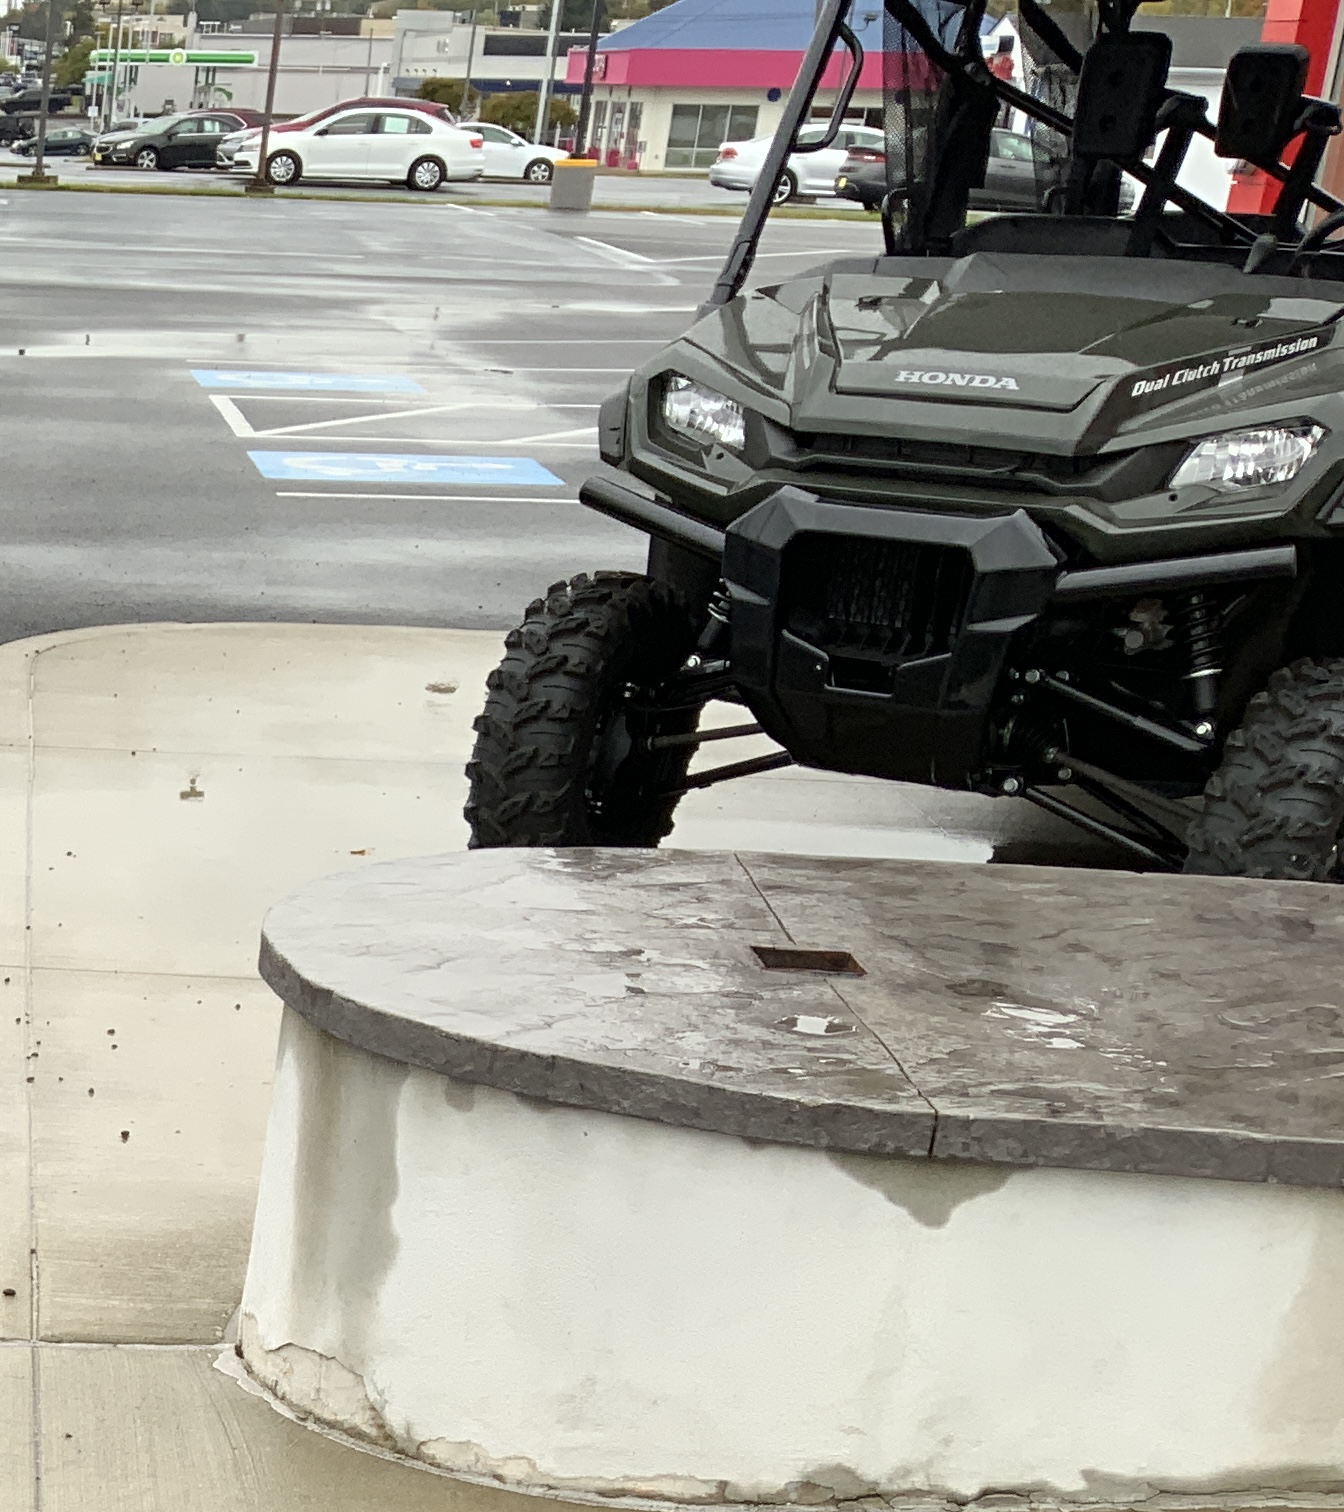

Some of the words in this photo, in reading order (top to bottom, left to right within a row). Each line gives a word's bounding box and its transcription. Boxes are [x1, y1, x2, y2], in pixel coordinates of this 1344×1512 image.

[895, 370, 1020, 390] HONDA
[1131, 374, 1169, 397] Dual
[1171, 359, 1221, 386] Clutch
[1222, 336, 1318, 372] Transmission
